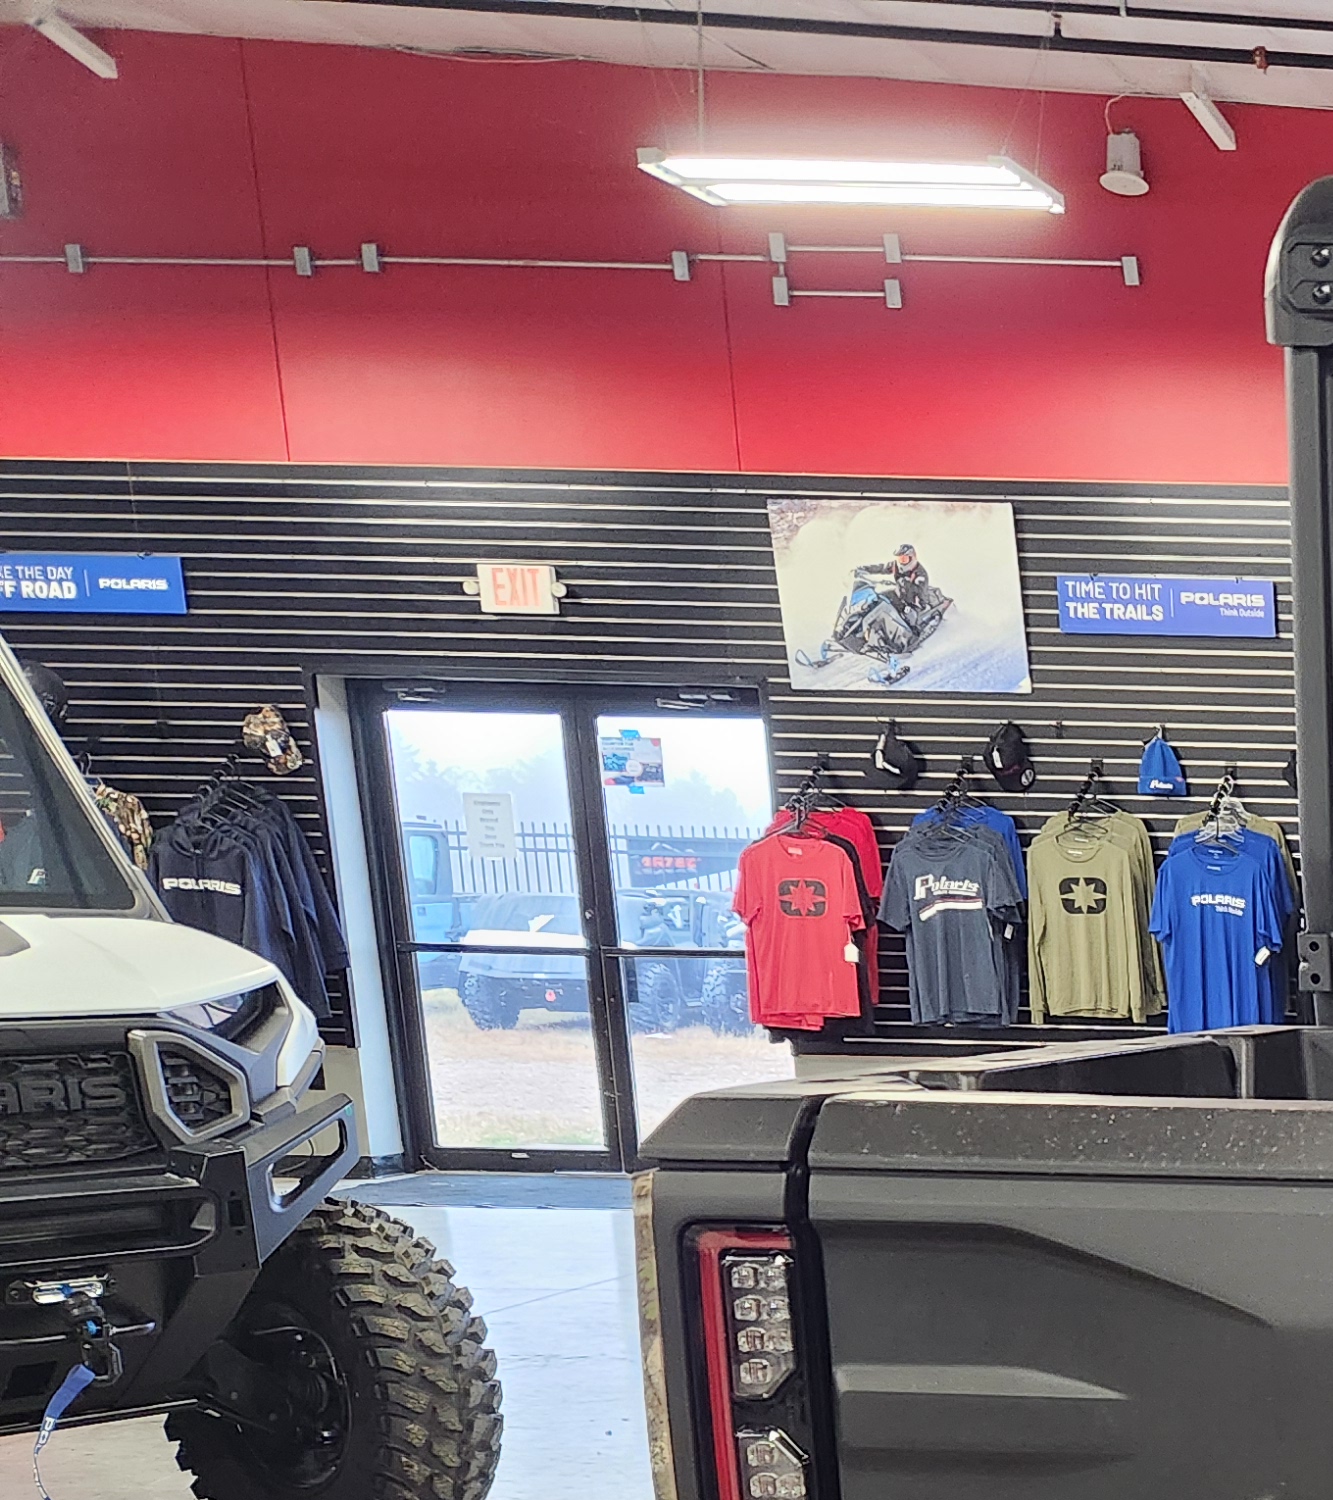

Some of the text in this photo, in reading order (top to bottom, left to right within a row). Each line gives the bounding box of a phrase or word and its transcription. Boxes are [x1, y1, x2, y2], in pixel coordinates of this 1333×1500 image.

[15, 566, 44, 580] THE
[47, 566, 74, 580] DAY
[20, 581, 77, 599] ROAD
[98, 578, 169, 591] POLARIS
[491, 567, 541, 607] EXIT
[1065, 580, 1162, 601] TIME TO HIT
[1179, 591, 1266, 607] POLARIS
[1065, 601, 1164, 621] THE TRAILS
[1219, 607, 1265, 618] Think Outside
[162, 877, 242, 896] POLARIS
[914, 873, 980, 900] Polaris
[1191, 893, 1246, 909] POLARIS
